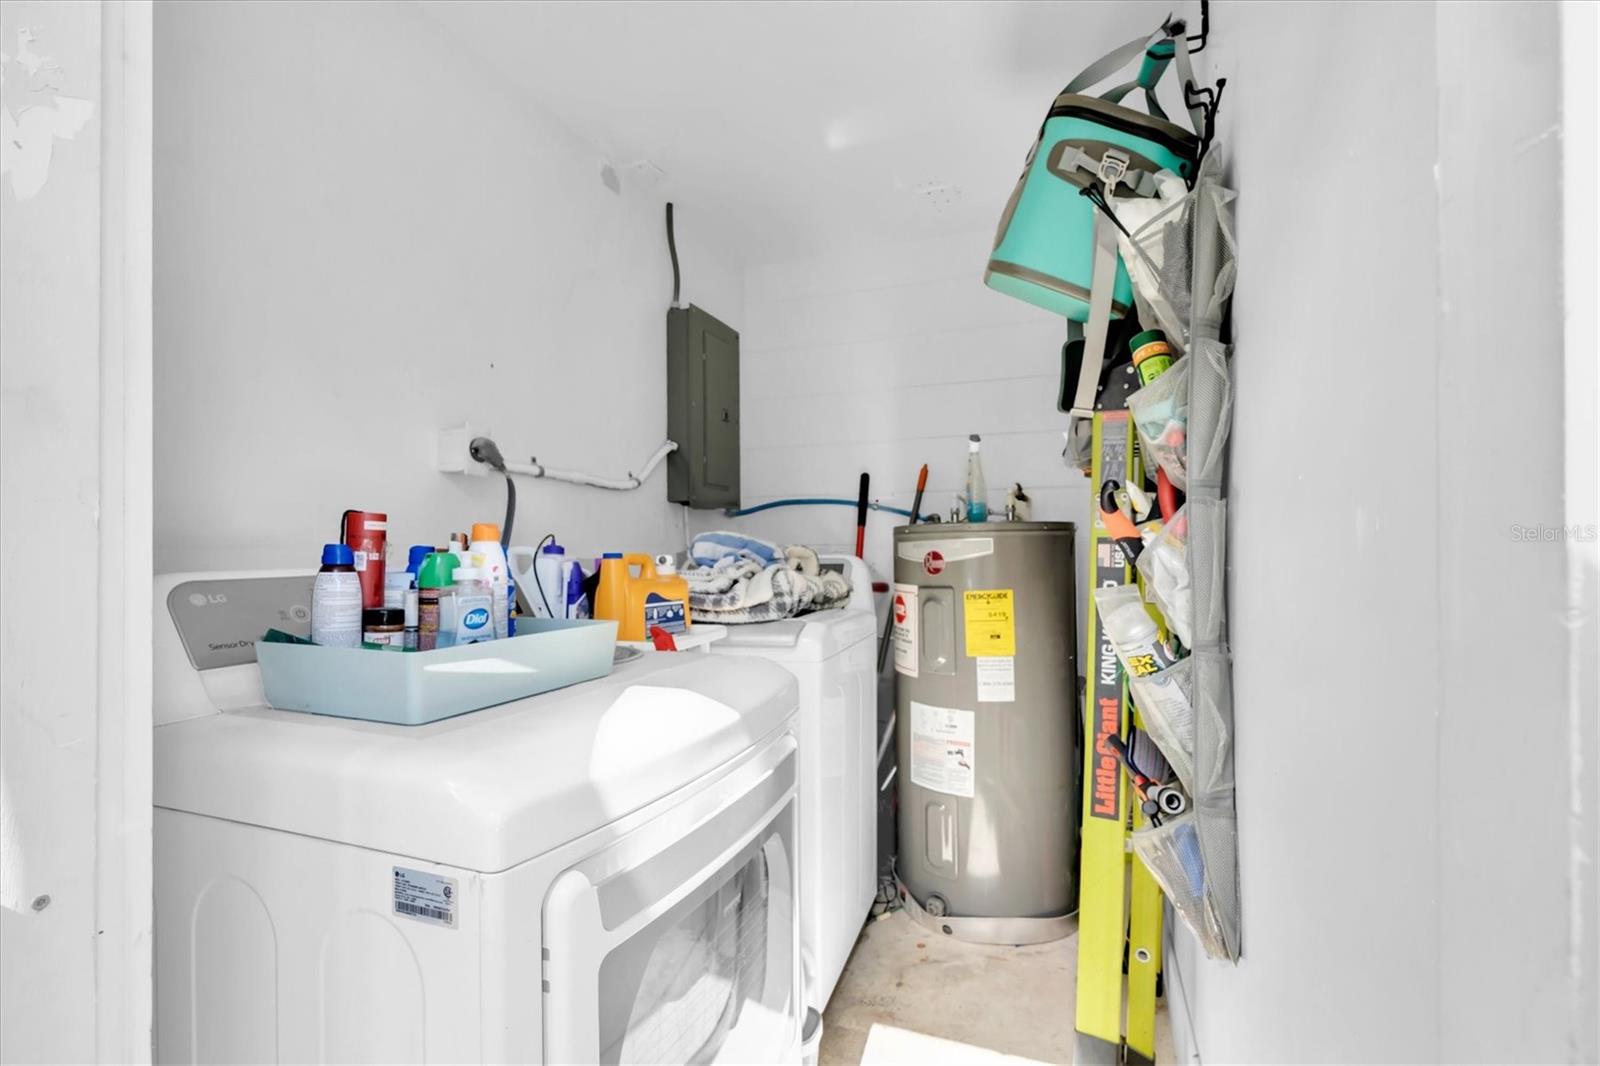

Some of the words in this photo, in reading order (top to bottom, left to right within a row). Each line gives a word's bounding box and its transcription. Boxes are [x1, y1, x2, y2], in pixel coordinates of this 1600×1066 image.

[208, 594, 227, 604] LG
[465, 612, 488, 625] Dial
[1100, 643, 1116, 684] KING
